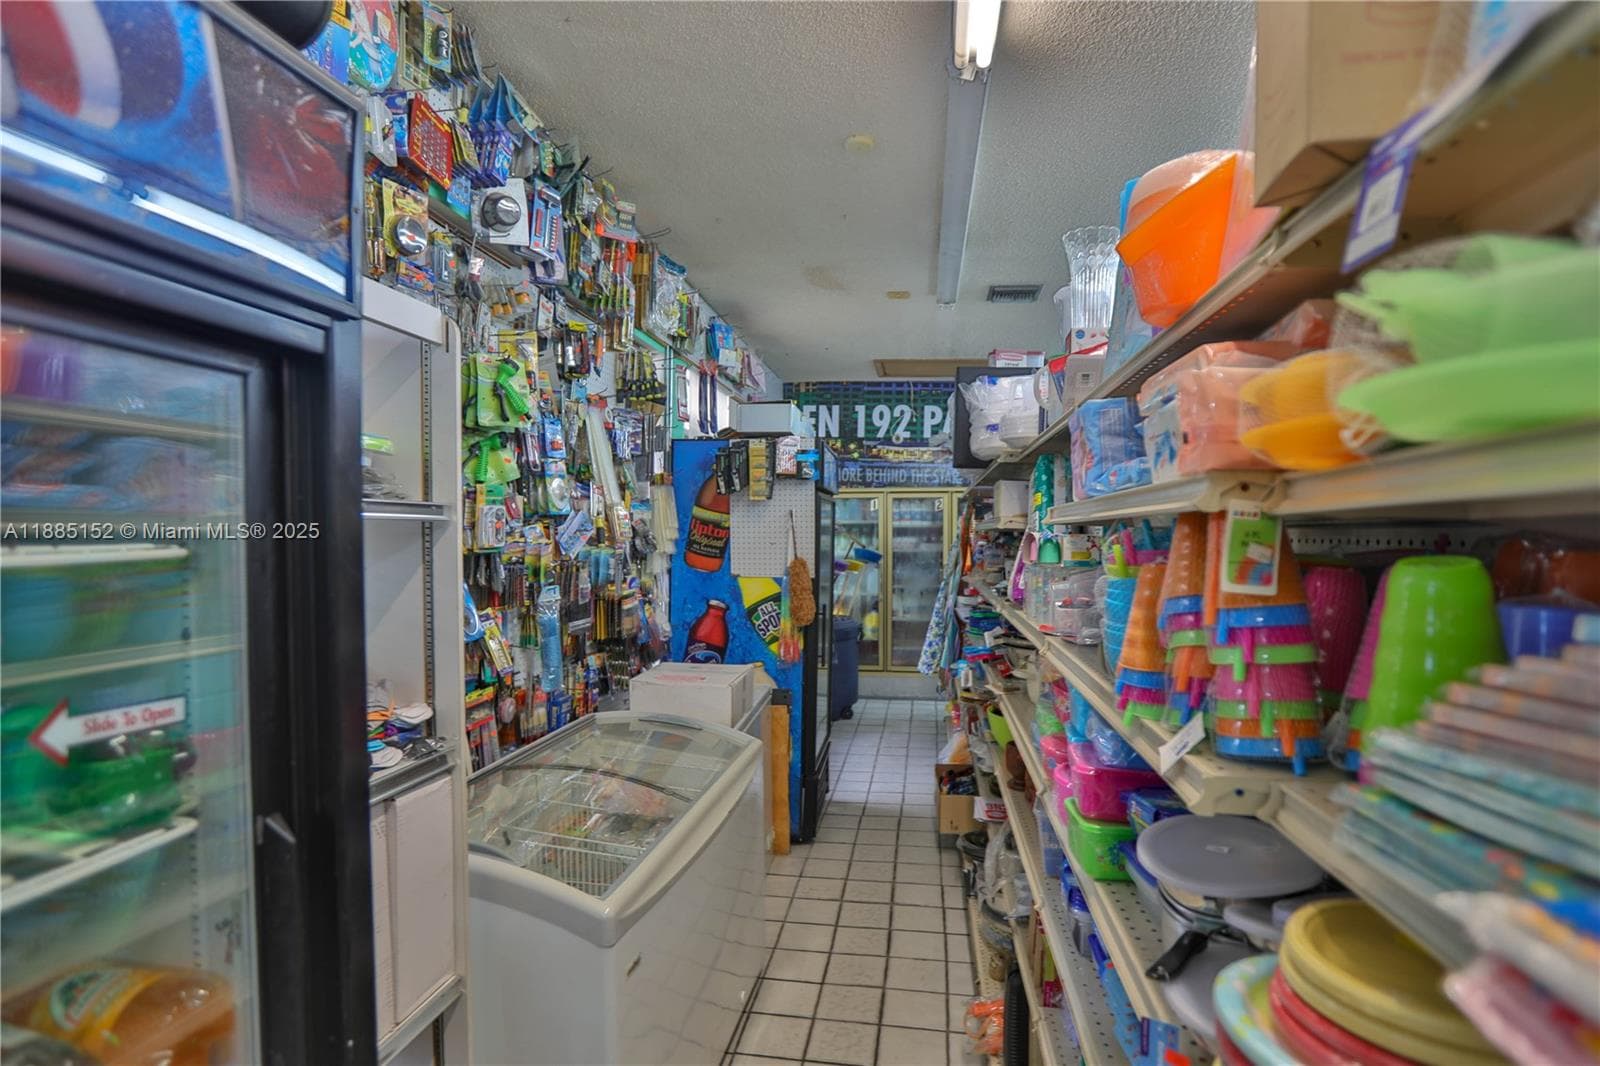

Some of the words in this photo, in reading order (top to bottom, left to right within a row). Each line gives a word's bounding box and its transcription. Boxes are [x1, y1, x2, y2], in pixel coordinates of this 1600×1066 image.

[855, 404, 912, 438] 192
[838, 468, 863, 482] ORE
[865, 468, 907, 483] BEHIND
[911, 469, 929, 483] THE
[759, 602, 778, 617] ALL
[84, 715, 115, 735] Slide
[122, 710, 137, 727] To
[142, 706, 176, 726] Open
